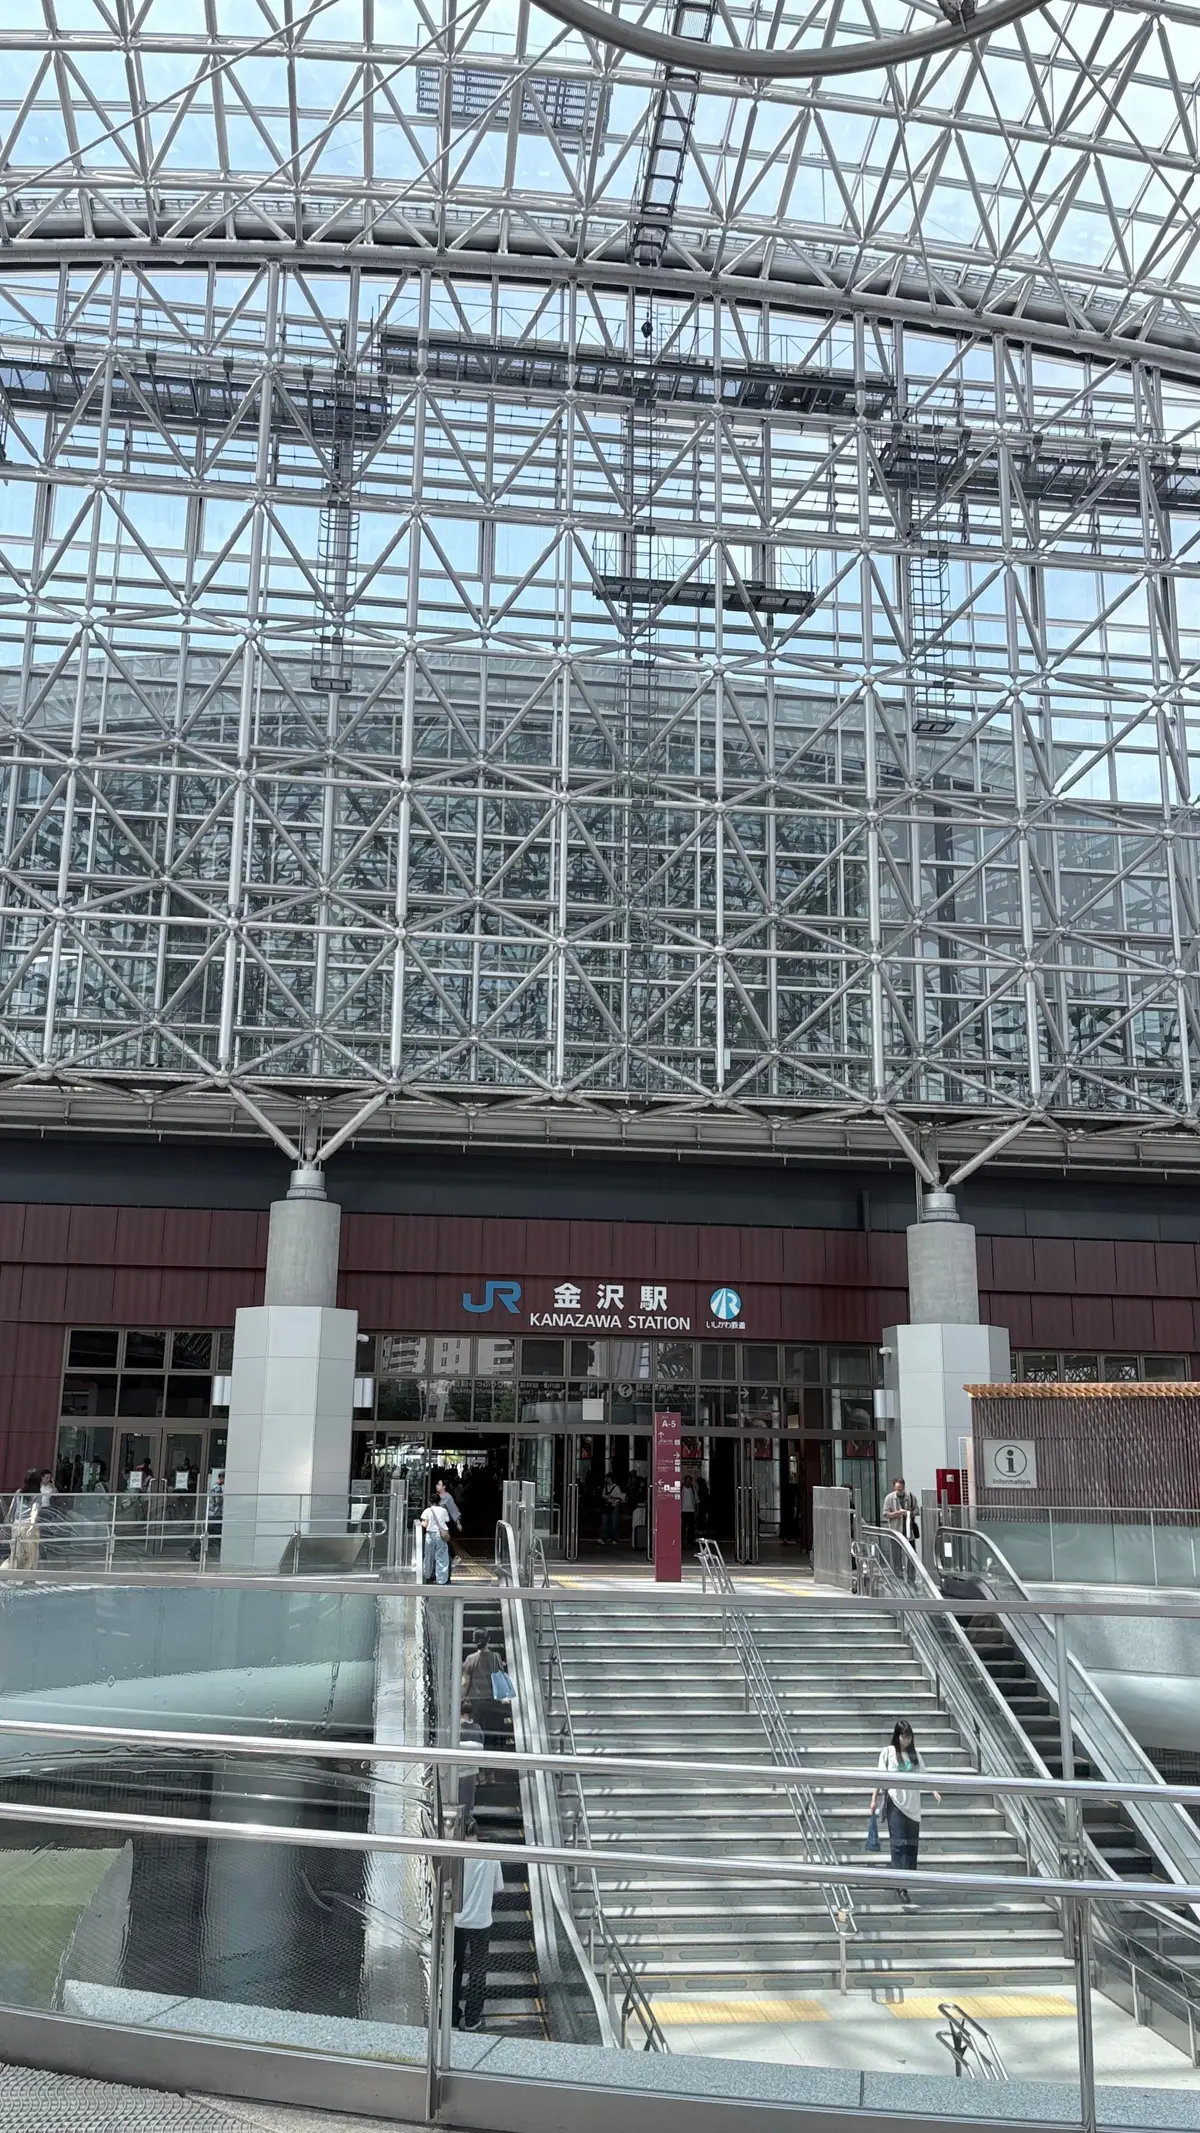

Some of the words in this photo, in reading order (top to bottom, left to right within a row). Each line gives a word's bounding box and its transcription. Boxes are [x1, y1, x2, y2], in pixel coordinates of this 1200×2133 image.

[462, 1280, 522, 1314] JR
[553, 1282, 668, 1311] 金沢駅
[530, 1312, 622, 1328] KANAZAWA
[628, 1315, 691, 1331] STATION
[760, 1387, 769, 1400] 2
[661, 1419, 677, 1428] A-5
